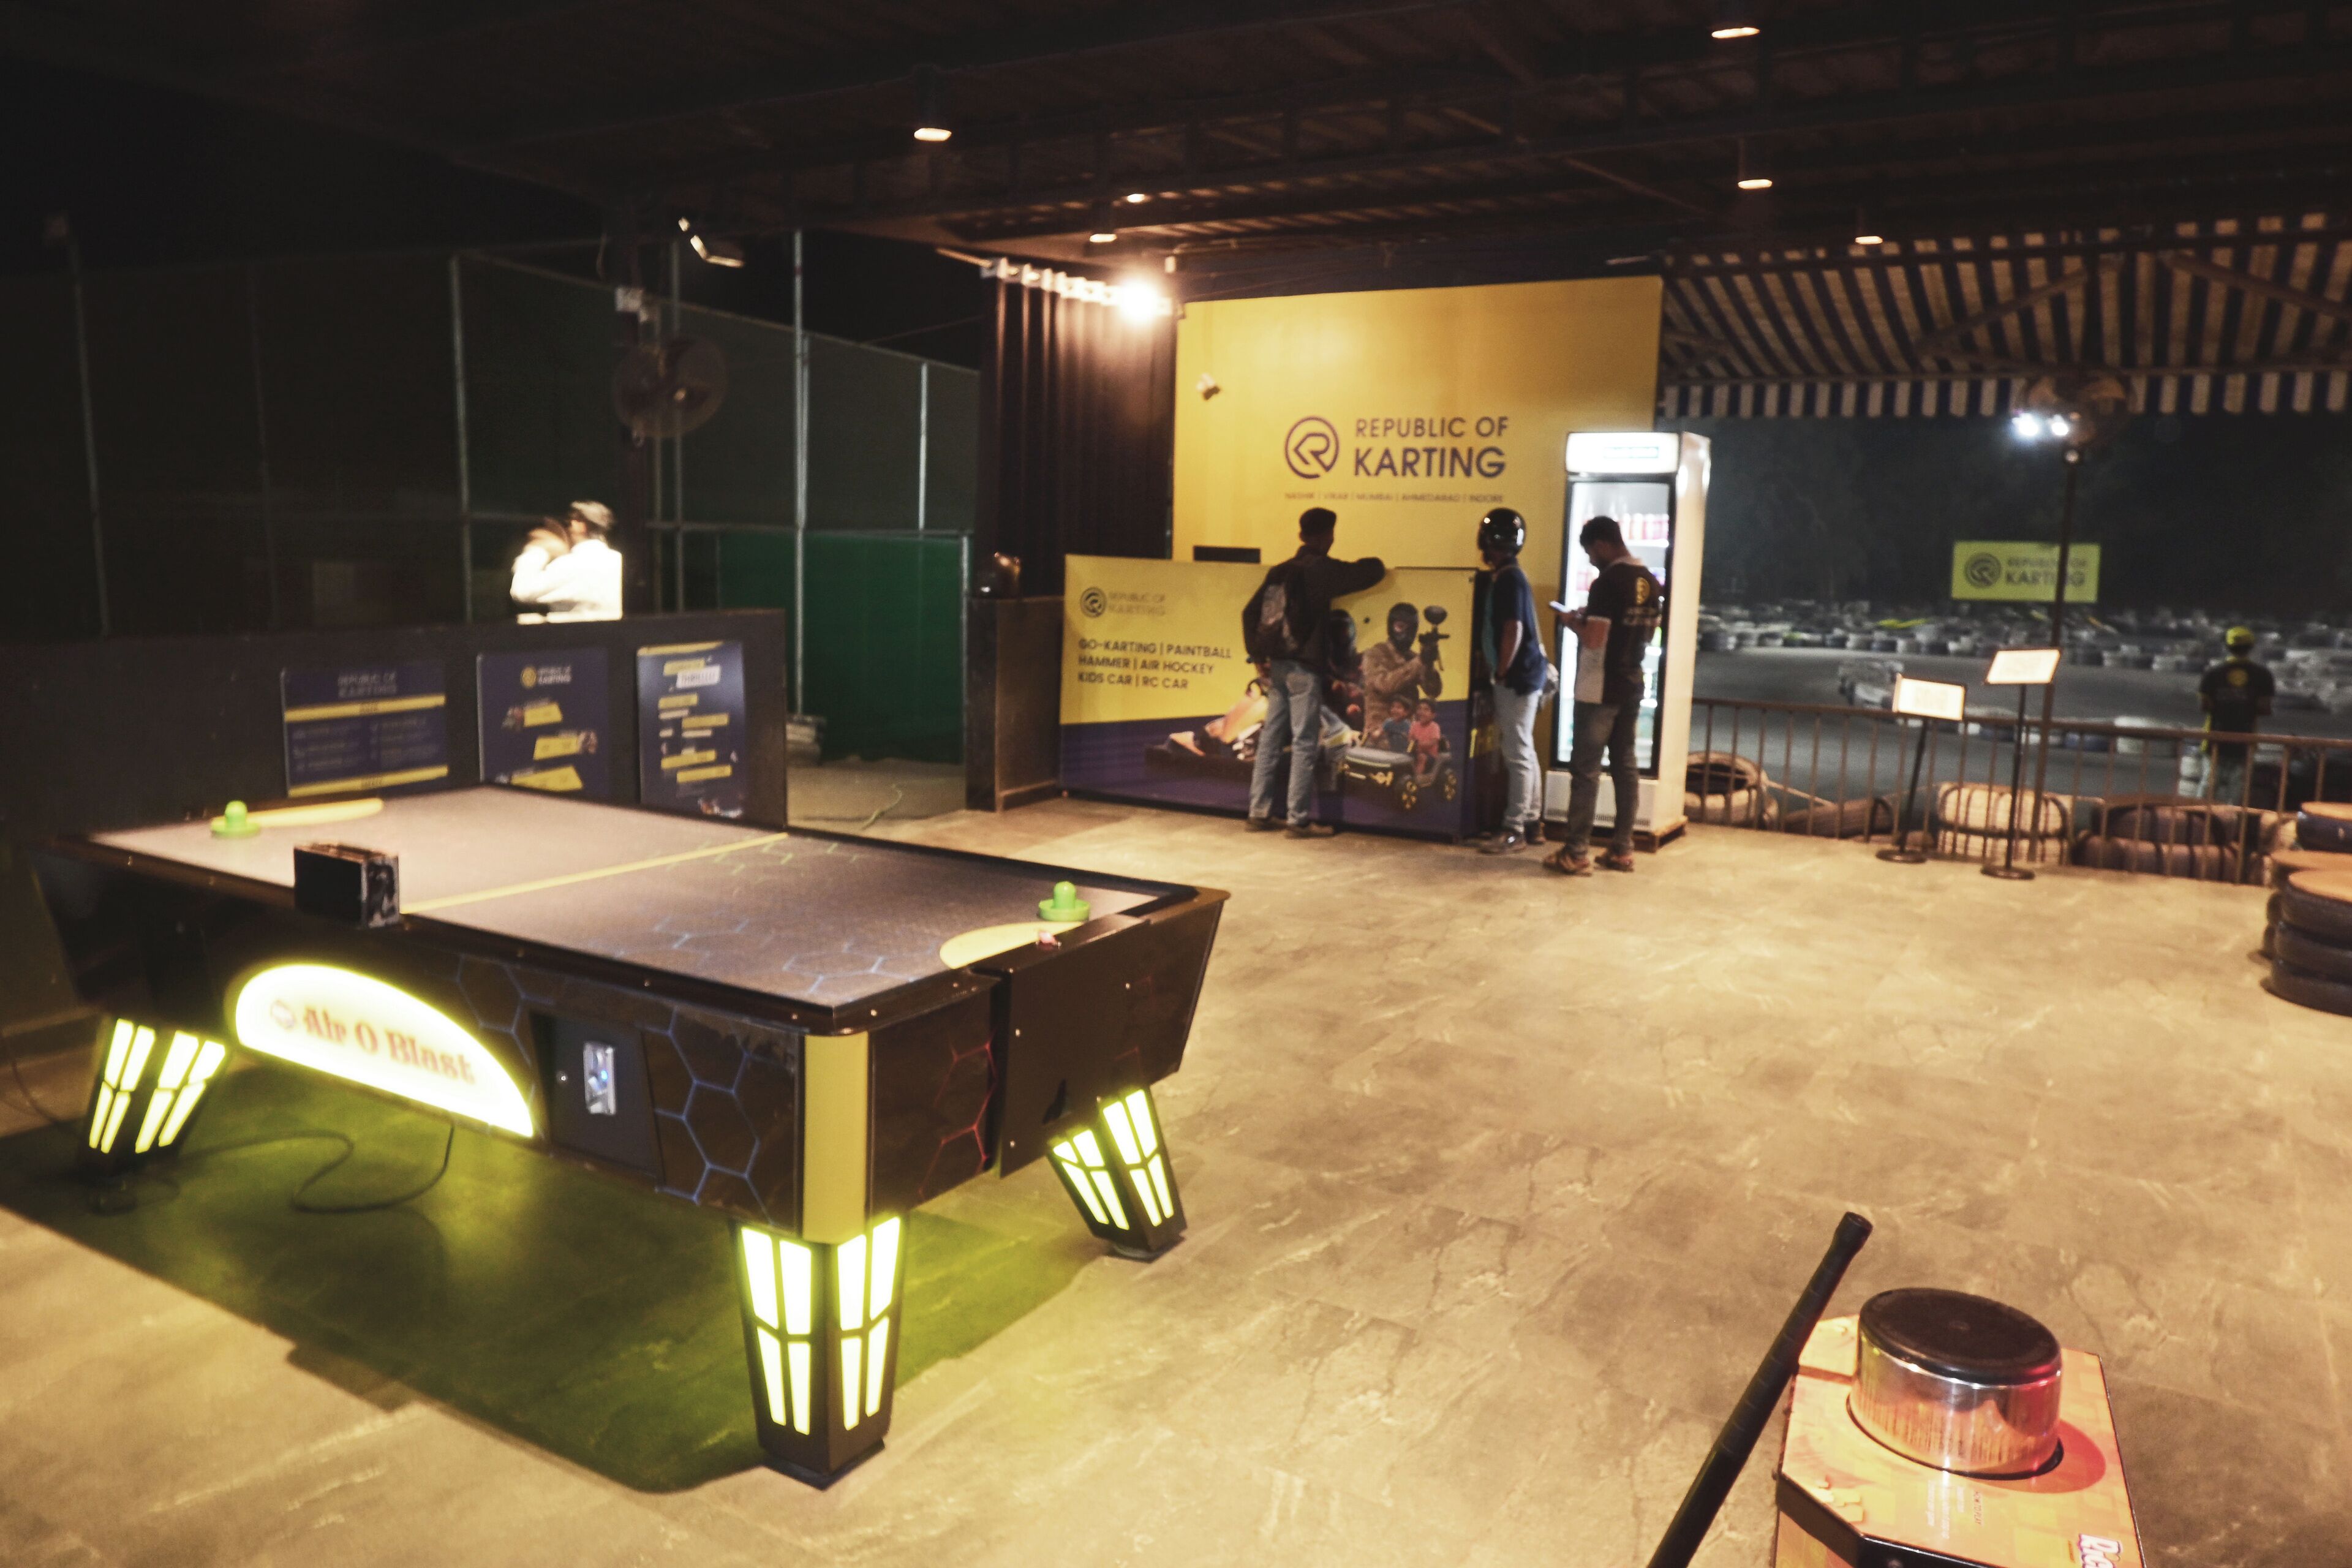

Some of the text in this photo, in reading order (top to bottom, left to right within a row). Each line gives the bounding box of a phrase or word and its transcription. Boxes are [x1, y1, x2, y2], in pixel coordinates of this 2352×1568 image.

[1355, 415, 1509, 438] REPUBLIC OF
[1354, 446, 1506, 478] KARTING
[1079, 639, 1231, 658] GO-KARTING PAINTBALL
[1079, 655, 1213, 674] HAMMER AIR HOCKEY
[1078, 672, 1188, 689] KIDS CAR RC CAR
[304, 1007, 475, 1085] Air O Blast
